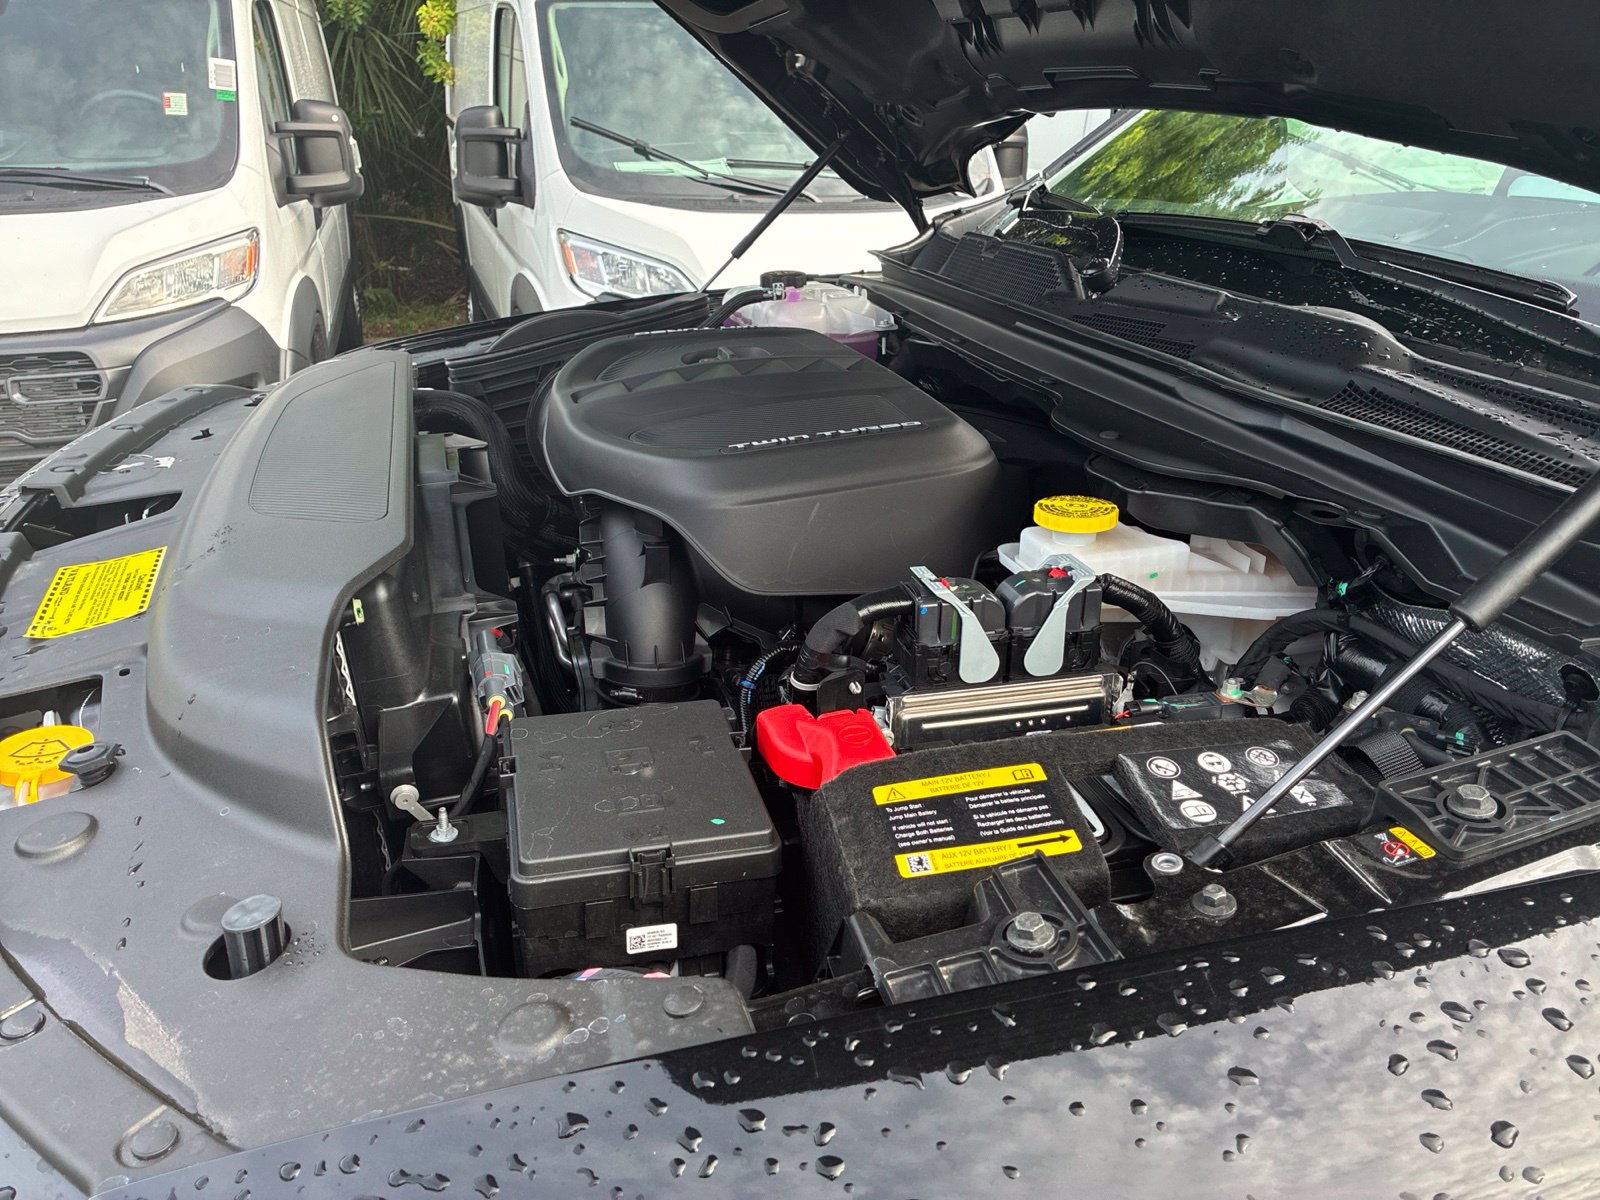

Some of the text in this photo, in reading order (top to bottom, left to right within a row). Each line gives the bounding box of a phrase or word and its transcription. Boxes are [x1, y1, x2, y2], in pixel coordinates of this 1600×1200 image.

[816, 421, 922, 437] TURBO
[954, 773, 985, 782] BATTERY
[930, 783, 961, 793] BATTERIE
[1000, 796, 1020, 804] batterie
[1020, 793, 1046, 802] principale
[918, 809, 937, 817] Battery
[976, 819, 1005, 827] Recharger
[1028, 812, 1051, 820] batteries
[897, 822, 916, 830] vehicle
[929, 826, 954, 834] Batteries
[911, 837, 933, 846] owner's
[933, 834, 956, 842] manual)
[941, 851, 957, 859] AUX
[959, 849, 972, 857] 12V
[973, 844, 1007, 856] BATTERY
[944, 859, 974, 869] BATTERIE
